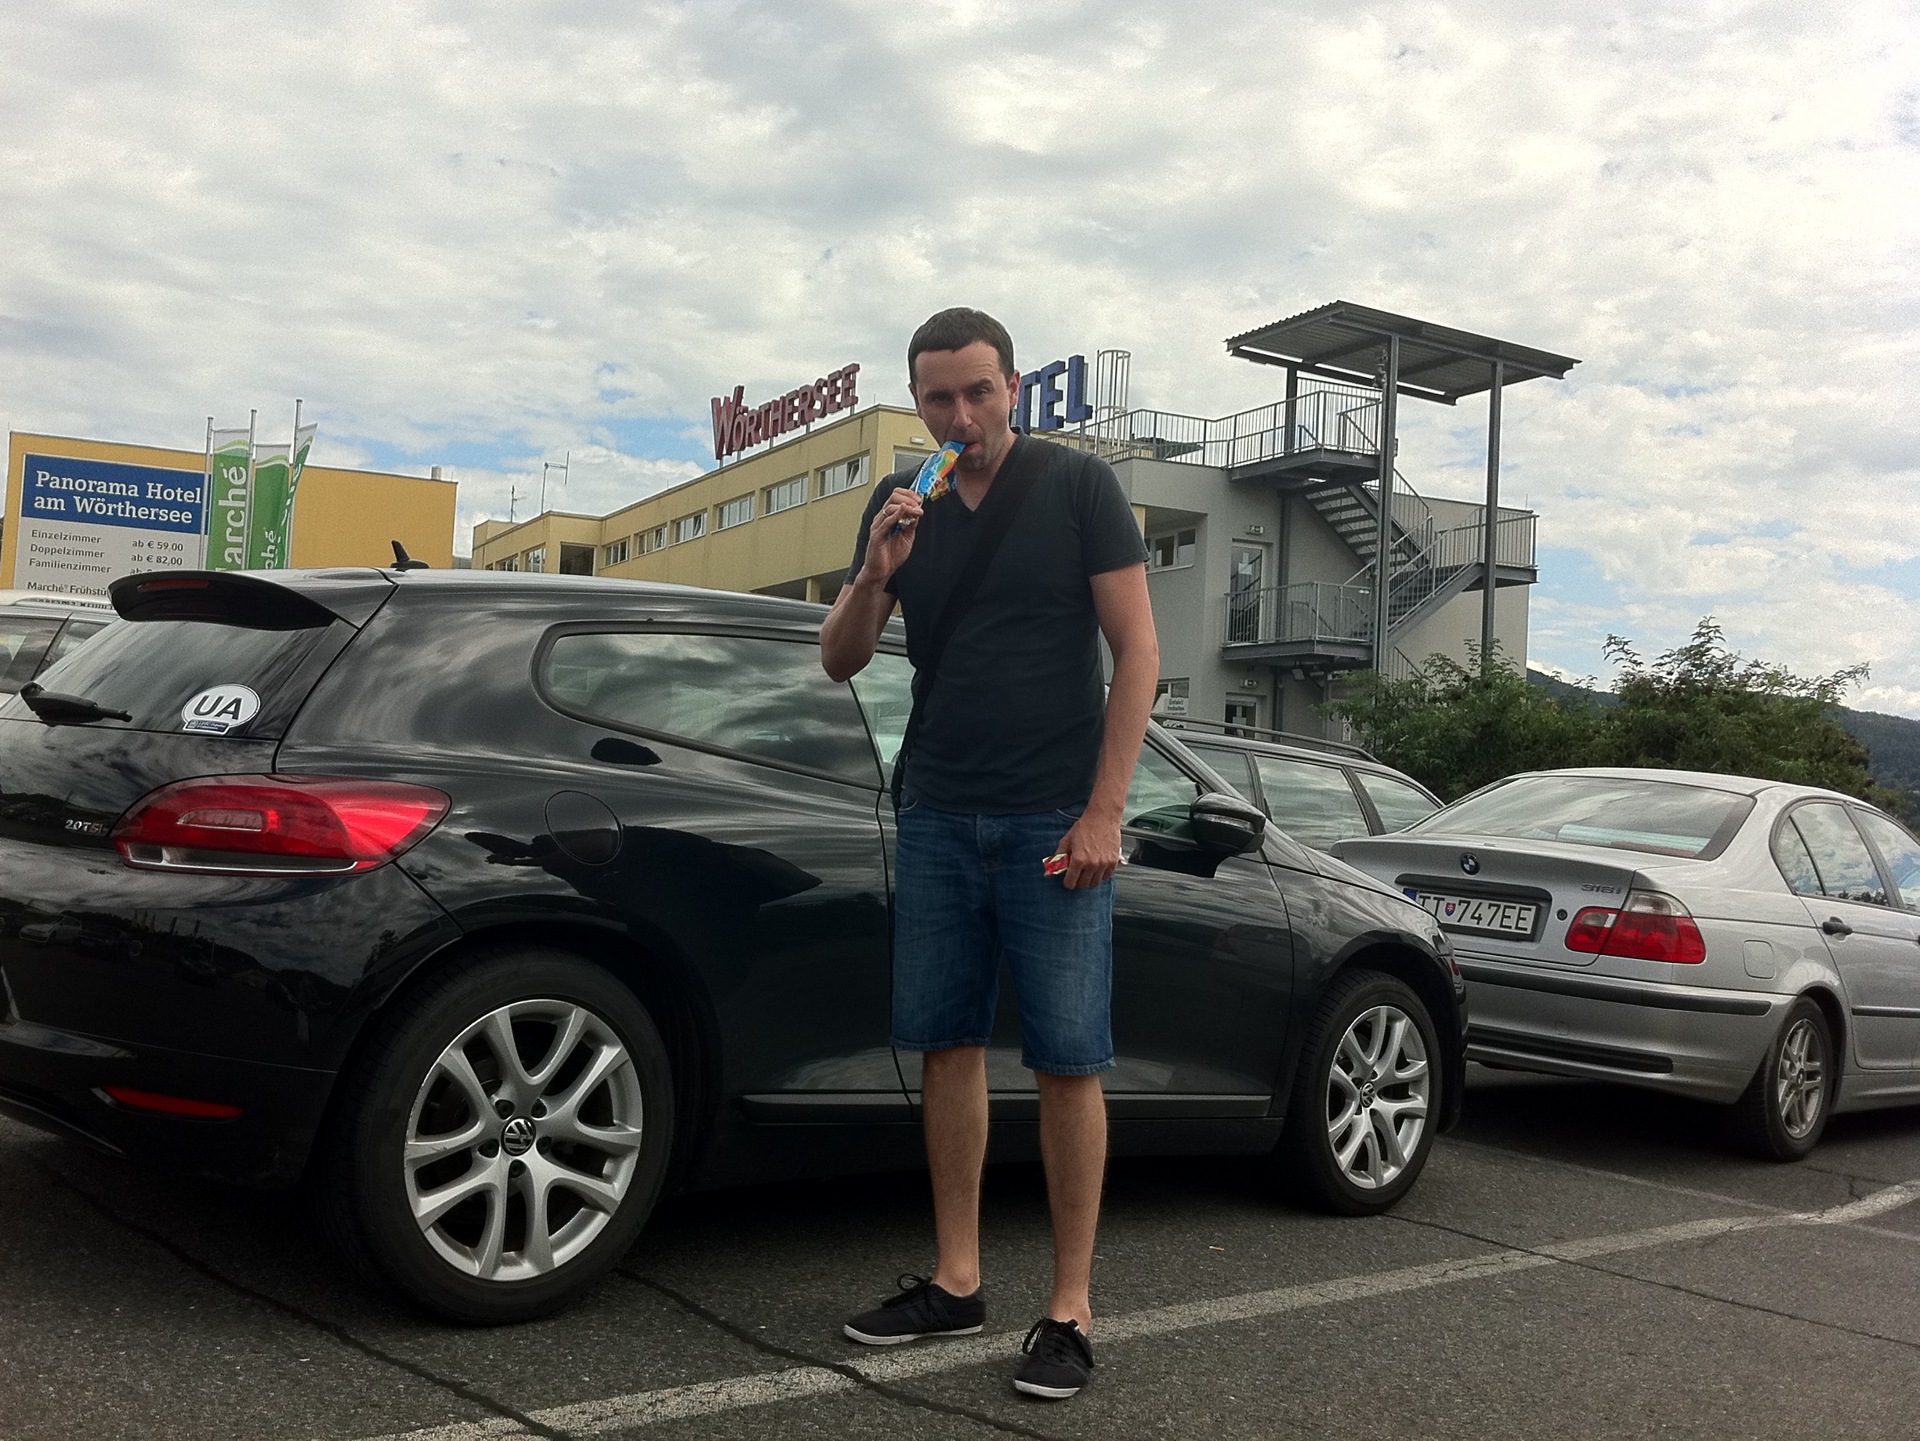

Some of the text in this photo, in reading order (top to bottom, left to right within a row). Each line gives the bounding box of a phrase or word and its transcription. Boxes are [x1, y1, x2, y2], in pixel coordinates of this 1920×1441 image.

[711, 355, 1093, 460] WÖRTHERSEE TEL
[35, 470, 202, 504] Panorama Hotel
[34, 496, 193, 524] am Wörthersee
[215, 466, 247, 571] arché
[31, 529, 102, 544] Einzelzimmer
[132, 540, 144, 548] ab
[156, 541, 184, 552] 59,00
[29, 558, 112, 574] Familienzimmer
[30, 544, 105, 558] Doppelzimmer
[131, 554, 143, 562] ab
[156, 556, 183, 566] 82,00
[69, 585, 107, 596] Frühstü
[193, 695, 243, 721] UA
[1457, 898, 1533, 932] 747EE
